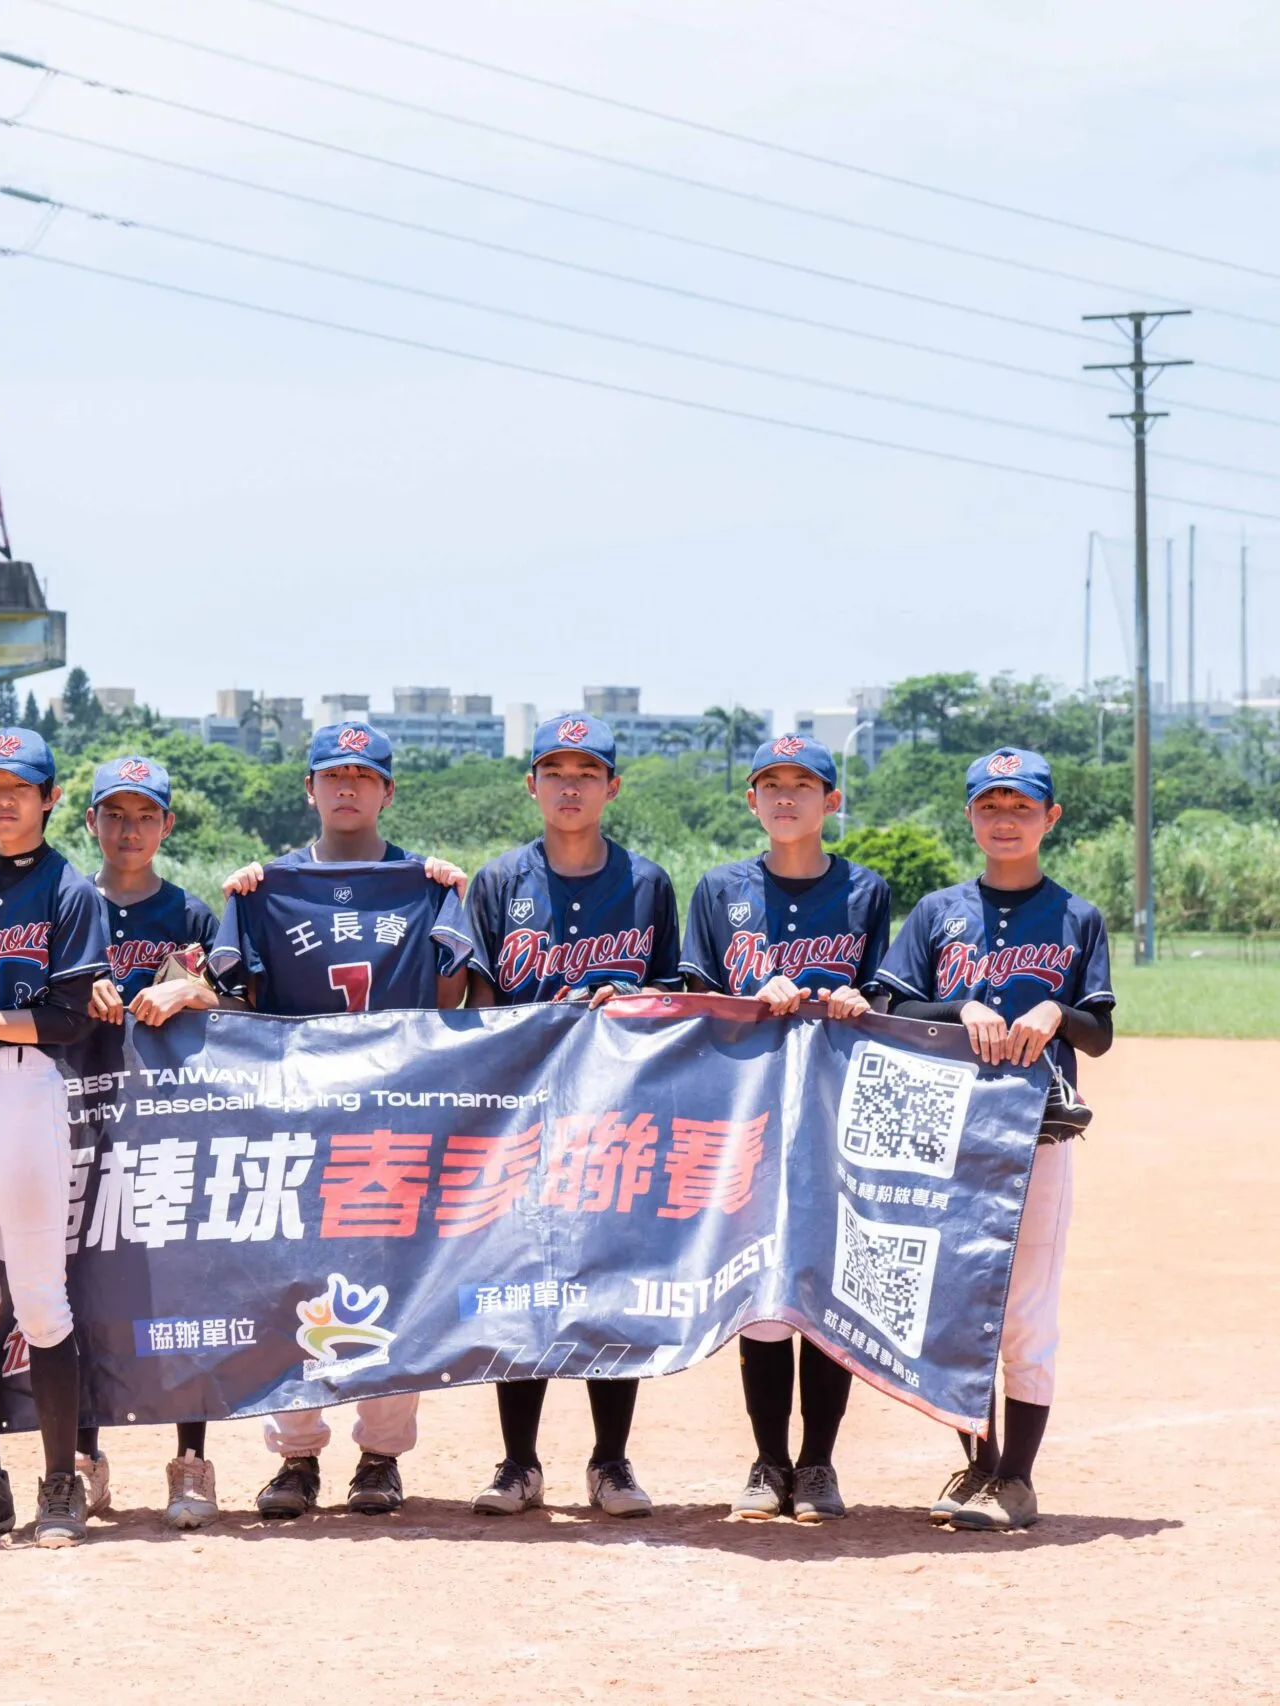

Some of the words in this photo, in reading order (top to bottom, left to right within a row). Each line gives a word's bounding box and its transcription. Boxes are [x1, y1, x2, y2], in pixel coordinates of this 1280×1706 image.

[285, 911, 408, 957] 王長睿
[498, 925, 655, 992] Dragons
[328, 961, 372, 1013] 7
[724, 931, 868, 996] Dragons
[937, 942, 1075, 1000] Dragons
[64, 1071, 132, 1097] BEST
[140, 1066, 260, 1087] TAIWAN
[68, 1102, 127, 1124] unity
[136, 1093, 255, 1116] Baseball
[371, 1089, 549, 1110] Tournament
[475, 1281, 589, 1315] 承辦單位
[623, 1277, 713, 1319] JUST
[714, 1234, 780, 1303] BEST
[148, 1317, 257, 1351] 協辦單位
[823, 1308, 920, 1388] 就是棒賽事網站
